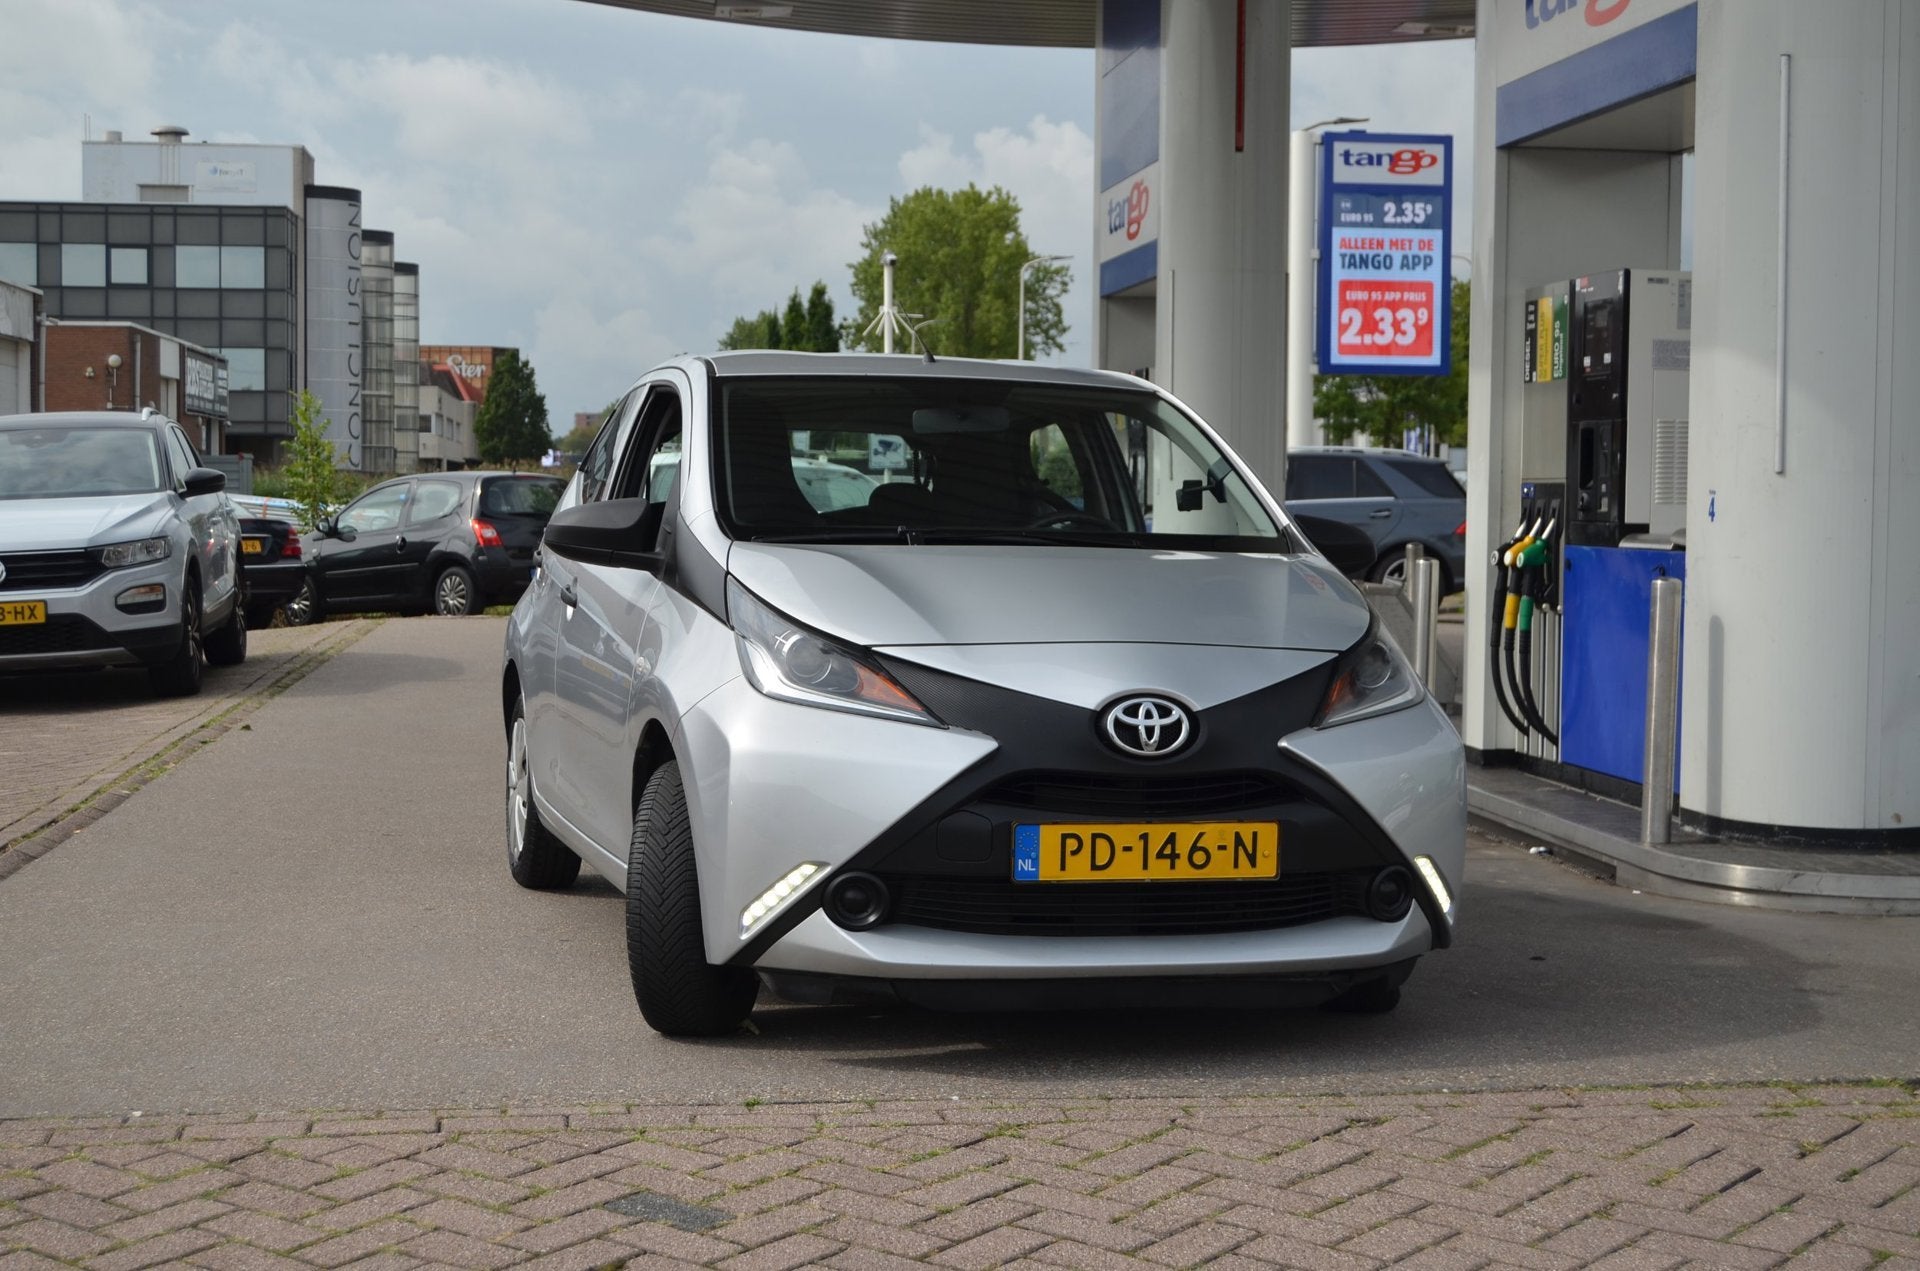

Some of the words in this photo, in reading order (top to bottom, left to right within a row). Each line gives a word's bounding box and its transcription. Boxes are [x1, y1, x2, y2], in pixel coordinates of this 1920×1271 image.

[1339, 149, 1438, 174] tango
[1108, 179, 1149, 241] tango
[1341, 213, 1362, 223] EURO
[1339, 237, 1385, 250] ALLEEN
[1389, 238, 1414, 251] MET
[1418, 239, 1434, 251] DE
[1339, 253, 1393, 270] TANGO
[1400, 254, 1434, 271] APP
[1346, 290, 1369, 301] EURO
[1371, 291, 1382, 301] 95
[1384, 292, 1401, 302] APP
[1554, 320, 1560, 338] 95
[1708, 497, 1715, 522] 4
[1018, 859, 1036, 871] NL
[1060, 831, 1258, 871] PD-146-N
